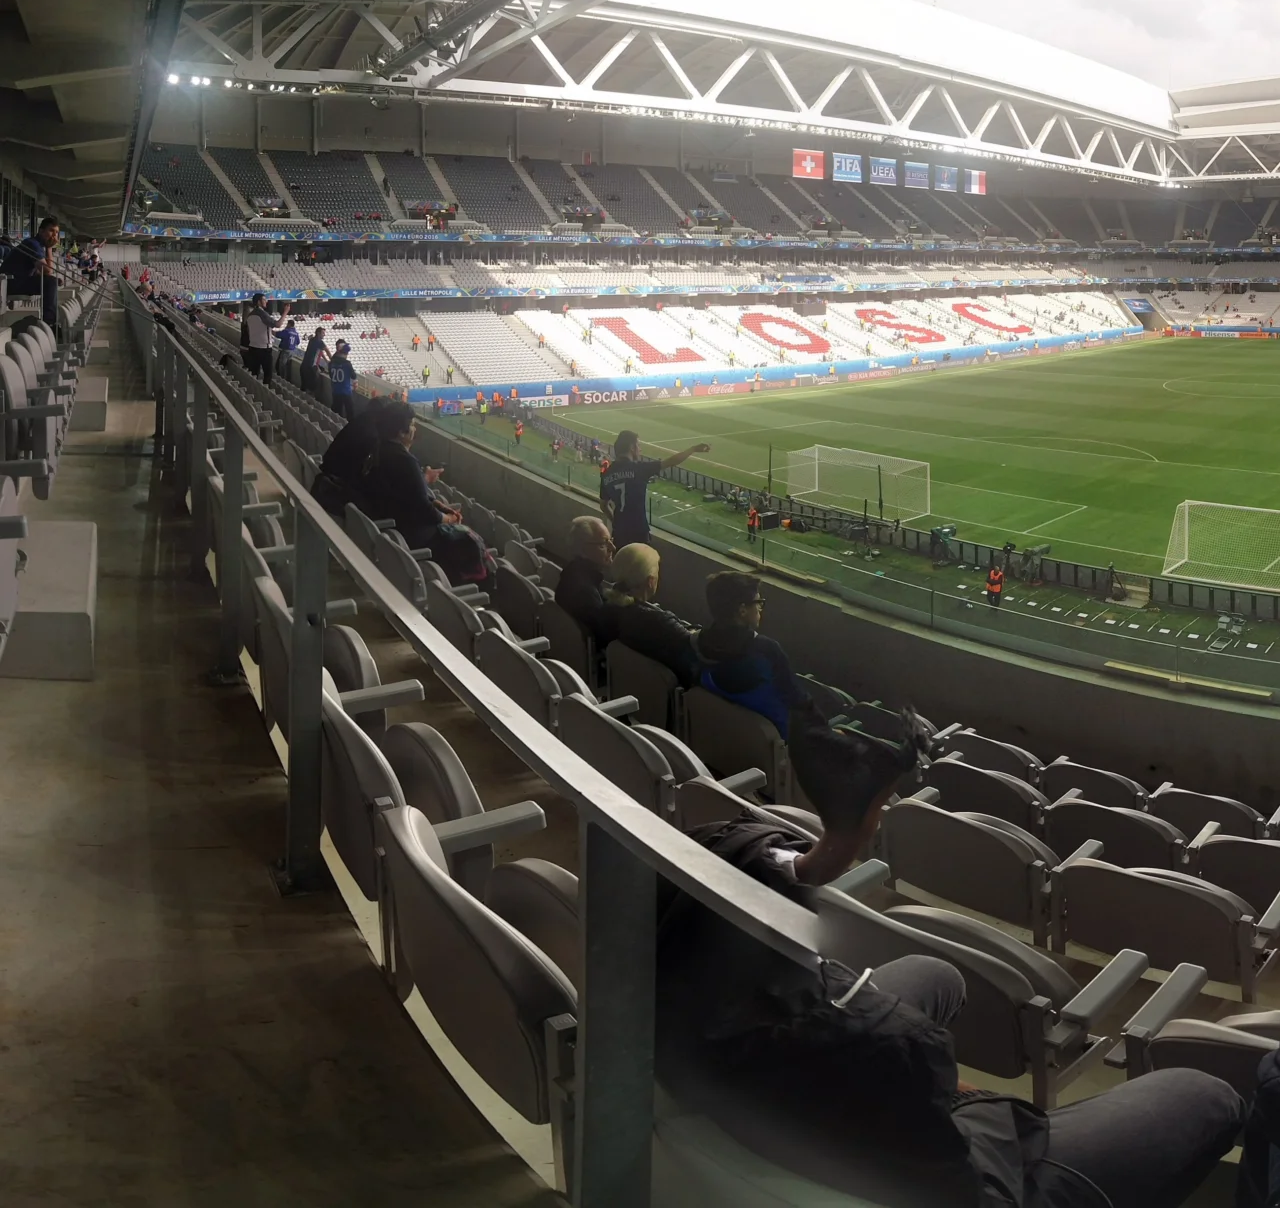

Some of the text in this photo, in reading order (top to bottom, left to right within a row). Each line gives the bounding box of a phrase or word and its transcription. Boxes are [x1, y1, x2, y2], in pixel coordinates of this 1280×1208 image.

[833, 157, 861, 173] FIFA
[871, 165, 896, 178] UEFA
[245, 231, 275, 239] MÉTROPOLE
[391, 233, 407, 241] UEFA
[409, 233, 424, 241] EURO
[420, 288, 453, 296] MÉTROPOLE
[331, 369, 344, 382] 20
[812, 374, 839, 384] Probably
[521, 397, 562, 407] sense
[583, 390, 628, 405] SOCAR
[613, 482, 626, 512] 7
